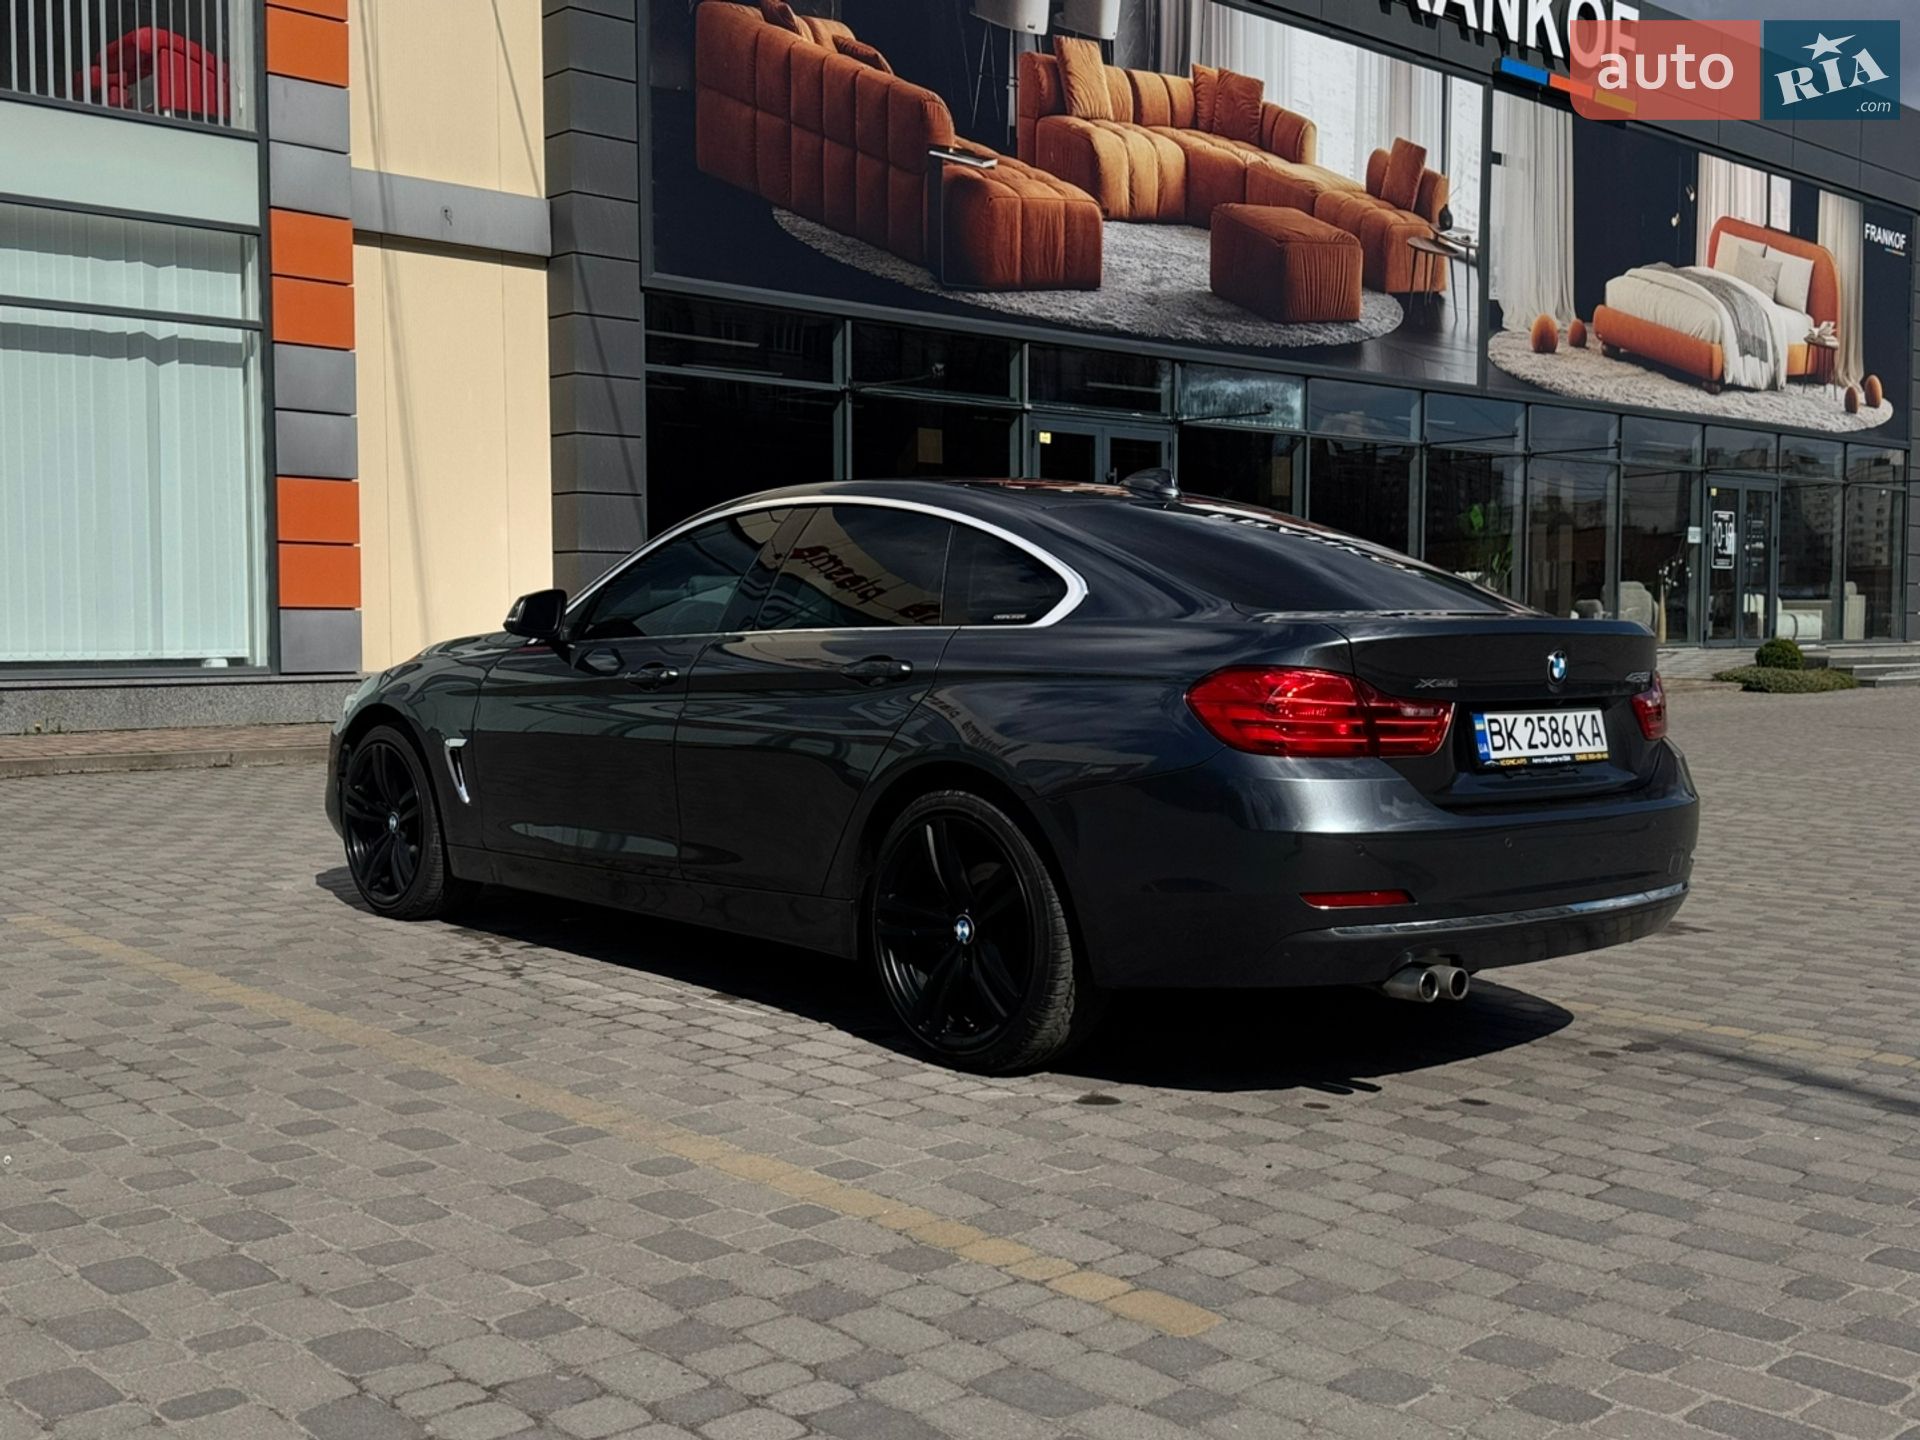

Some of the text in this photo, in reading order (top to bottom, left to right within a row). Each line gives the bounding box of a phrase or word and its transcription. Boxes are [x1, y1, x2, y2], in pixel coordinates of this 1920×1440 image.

[1864, 222, 1907, 250] FRANKOF
[1487, 714, 1604, 752] BK 2586 KA
